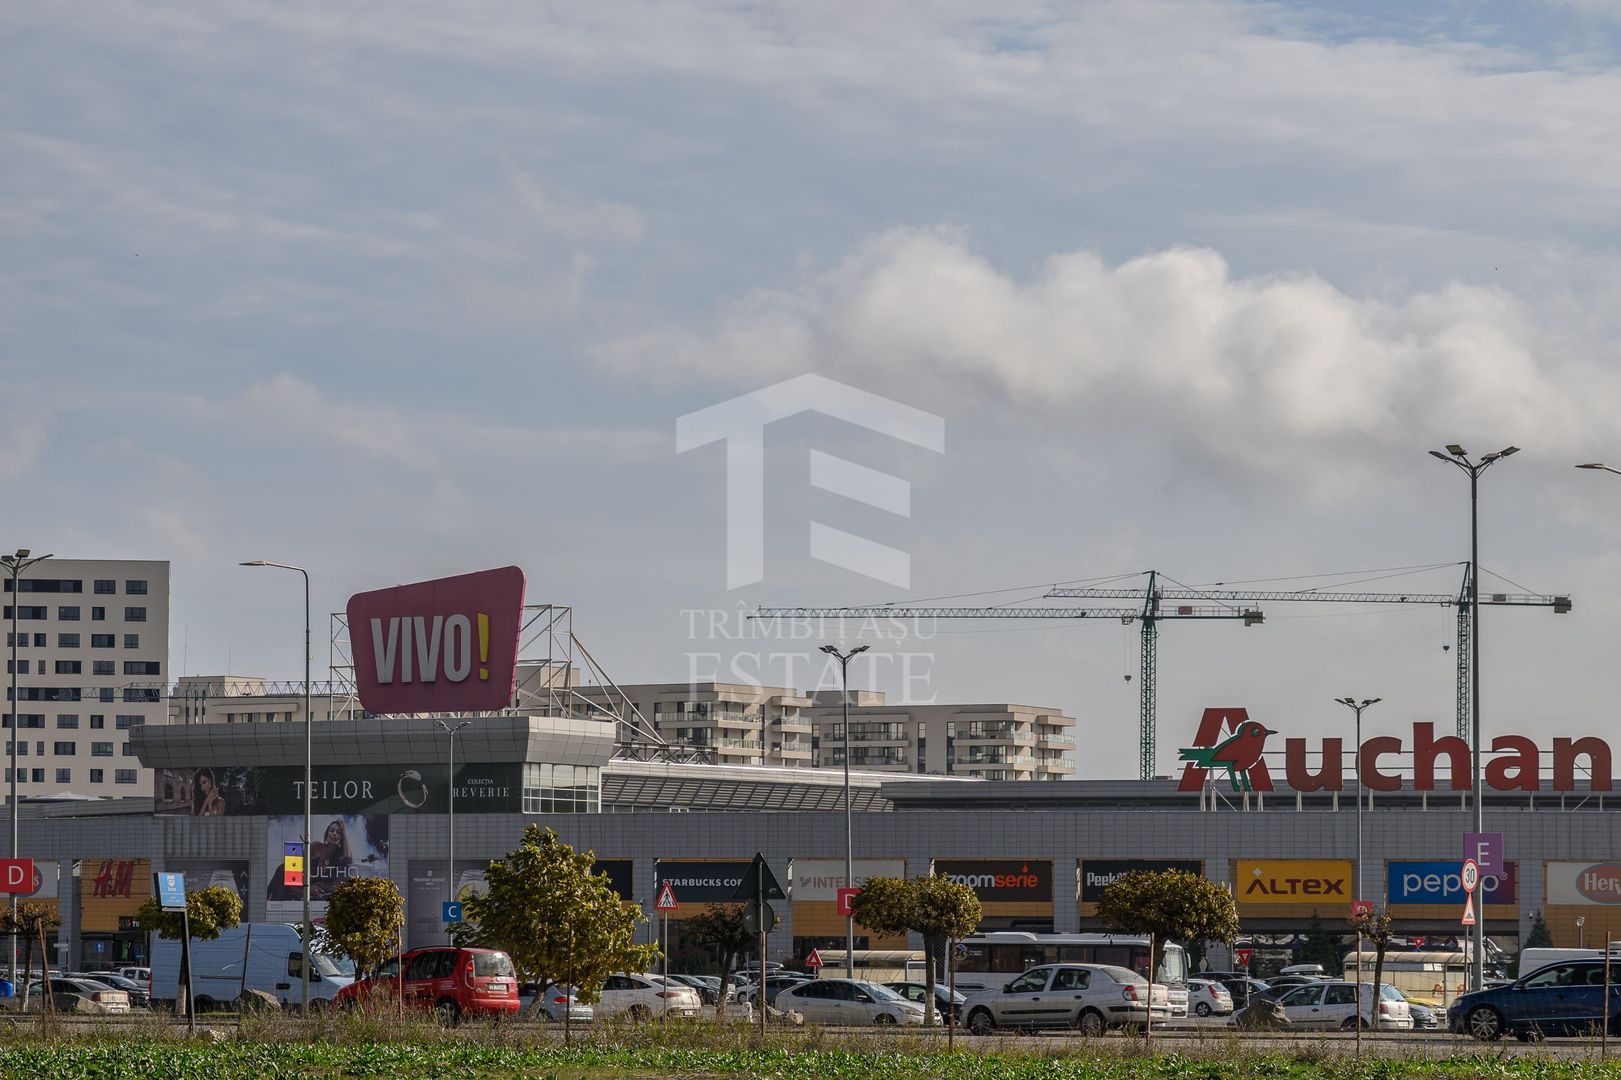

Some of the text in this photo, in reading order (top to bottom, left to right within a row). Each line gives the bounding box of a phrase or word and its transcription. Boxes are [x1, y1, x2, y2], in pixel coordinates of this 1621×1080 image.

[370, 612, 490, 684] VIVO!
[1177, 707, 1613, 792] Auchan
[293, 780, 374, 799] TEILOR
[453, 786, 510, 798] REVERIE
[1477, 842, 1490, 866] E
[8, 865, 24, 885] D
[92, 859, 135, 898] H&M
[662, 878, 743, 887] STARBUCKS COF
[1403, 872, 1499, 897] pepo
[1465, 868, 1475, 885] 30
[448, 905, 457, 918] C
